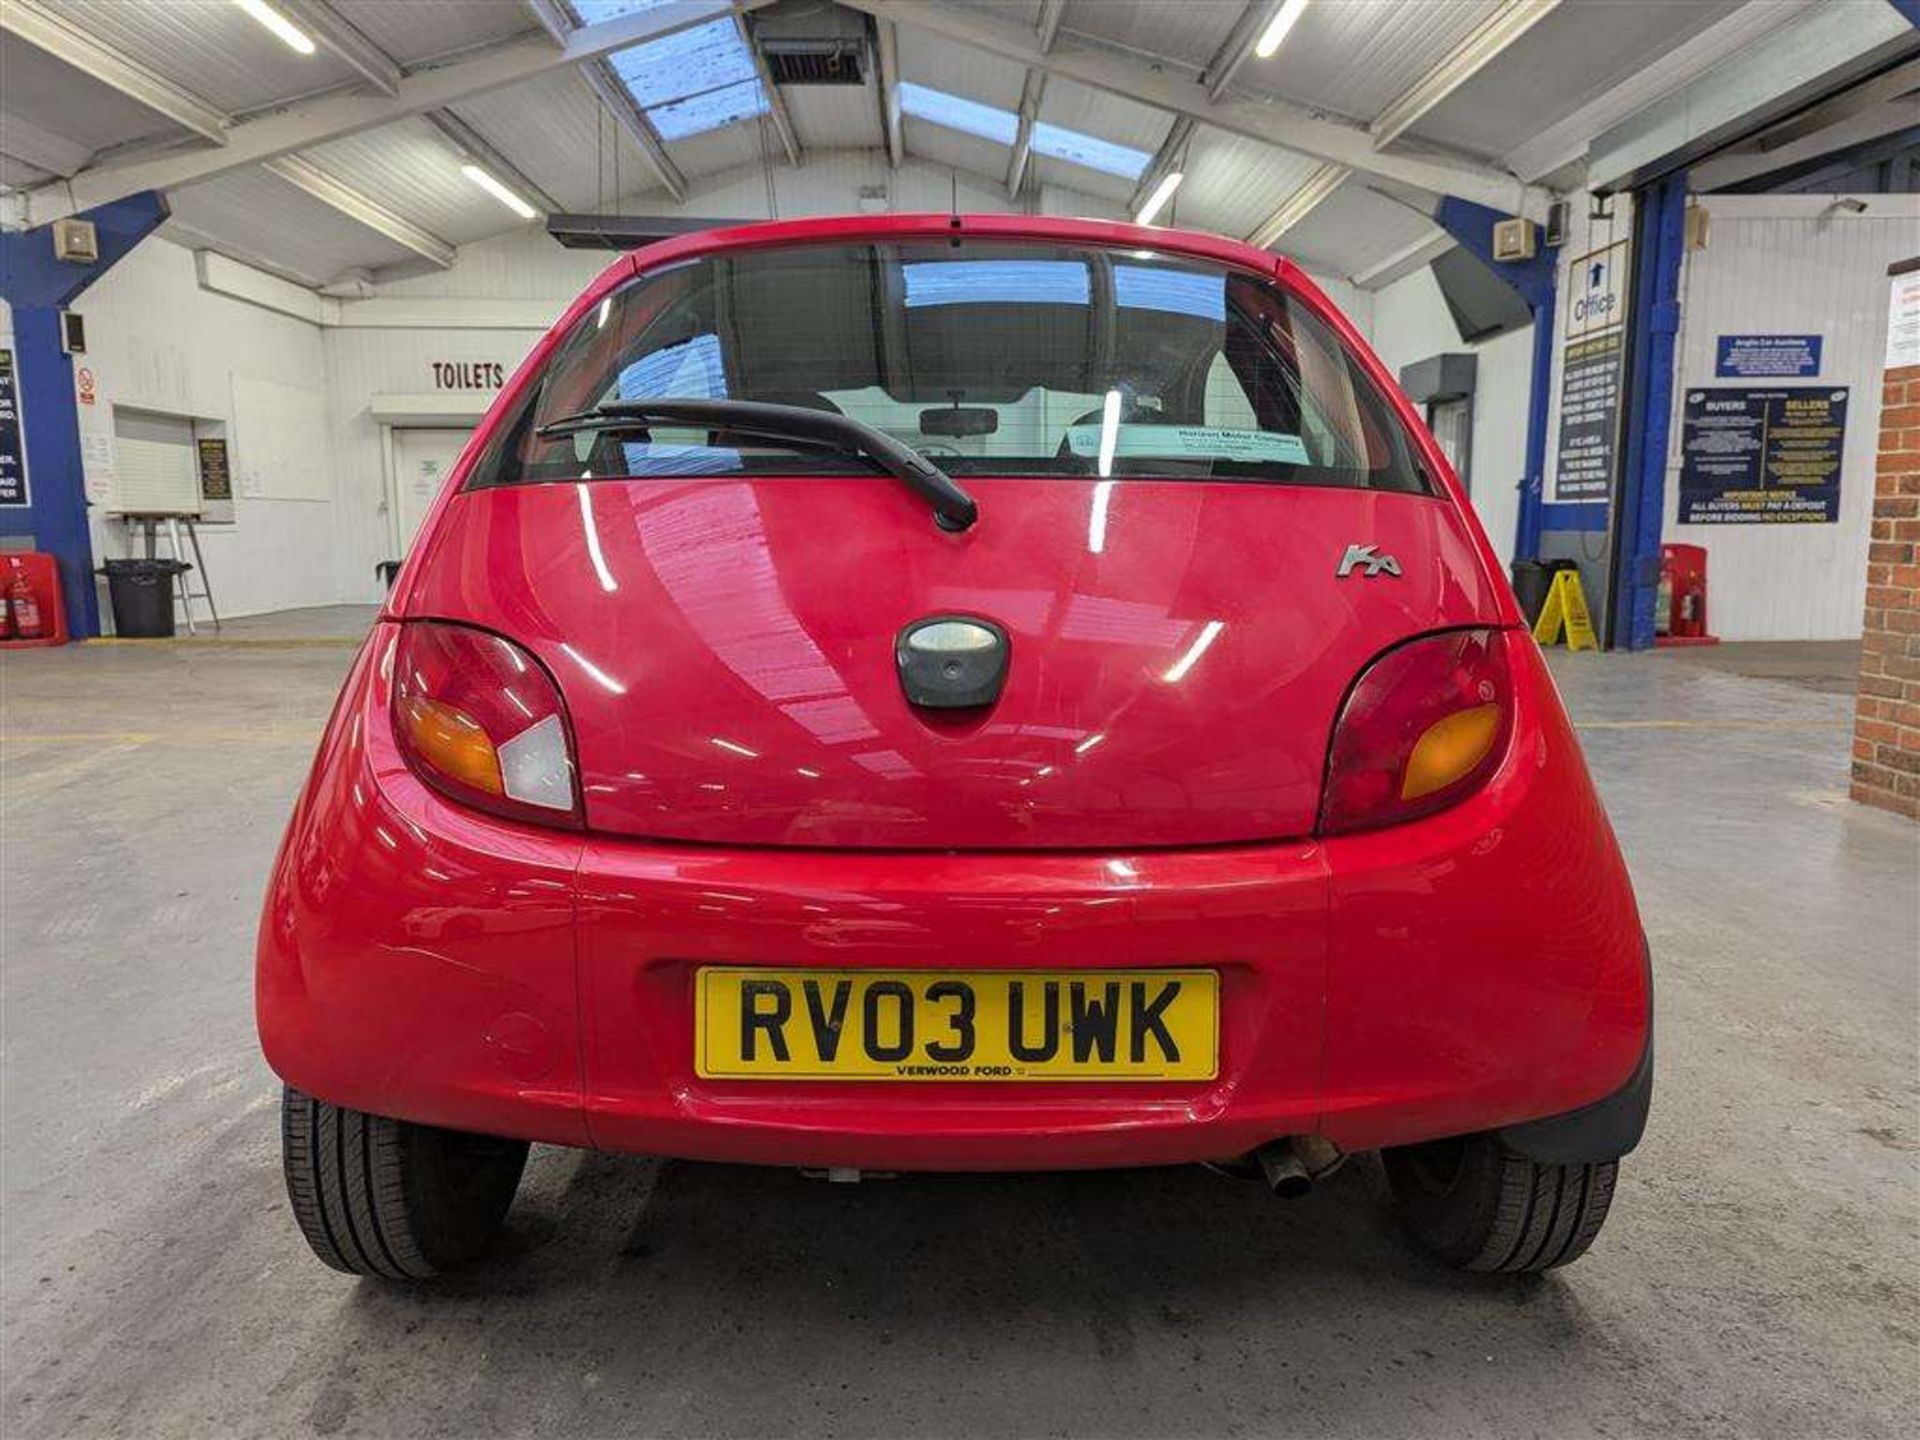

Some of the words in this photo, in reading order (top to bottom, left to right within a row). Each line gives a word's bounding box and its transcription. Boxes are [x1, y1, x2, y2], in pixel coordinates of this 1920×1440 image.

[1574, 293, 1615, 322] Office
[432, 362, 504, 389] TOILETS
[1706, 401, 1746, 411] BUYERS
[1786, 400, 1829, 410] SELLERS
[1690, 502, 1706, 511] ALL
[1707, 502, 1740, 511] BUYERS
[1689, 513, 1723, 522] BEFORE
[740, 979, 977, 1063] RV03
[1007, 980, 1182, 1064] UWK
[896, 1065, 970, 1077] VERWOOD
[974, 1065, 1012, 1077] FORD
